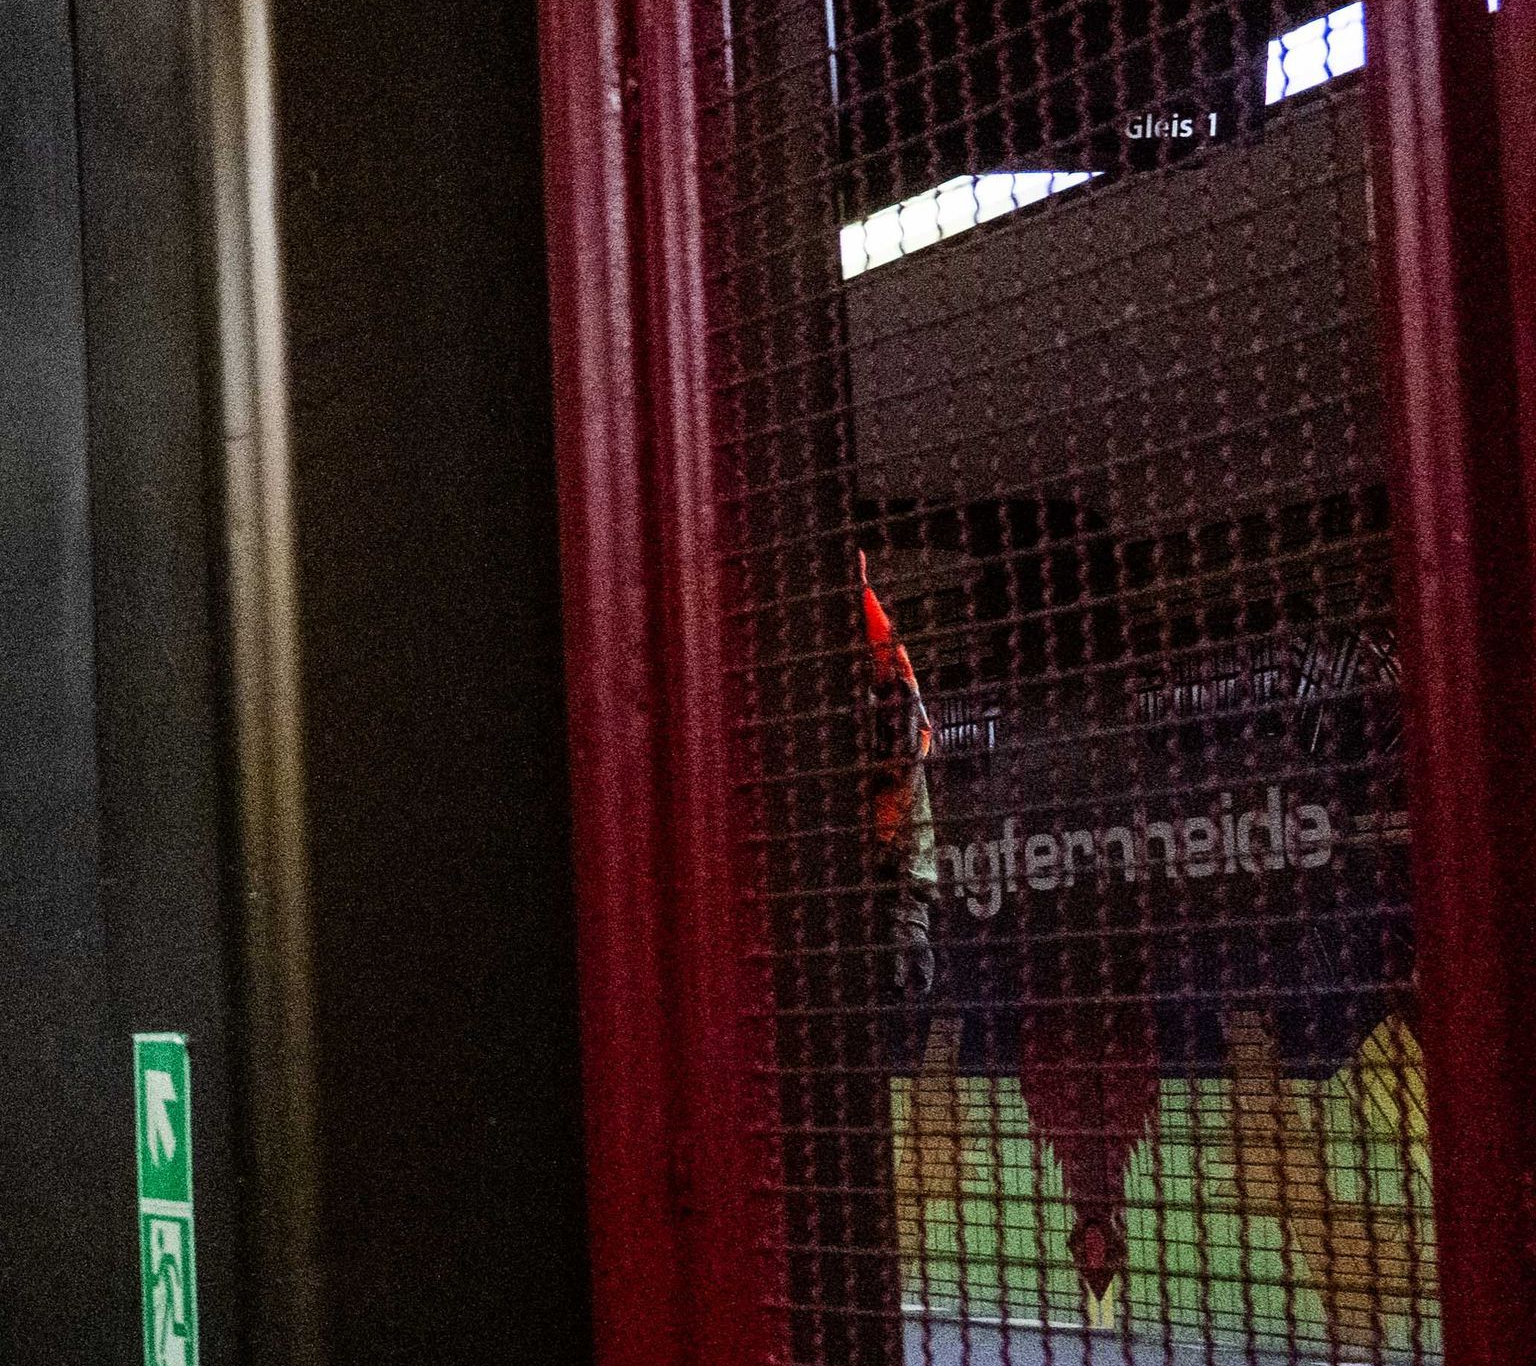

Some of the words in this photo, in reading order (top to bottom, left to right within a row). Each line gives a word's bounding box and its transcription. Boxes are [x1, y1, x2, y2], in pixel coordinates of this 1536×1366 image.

[1125, 112, 1194, 140] Gleis
[1207, 111, 1218, 138] 1
[935, 786, 1333, 918] ngfernheide
